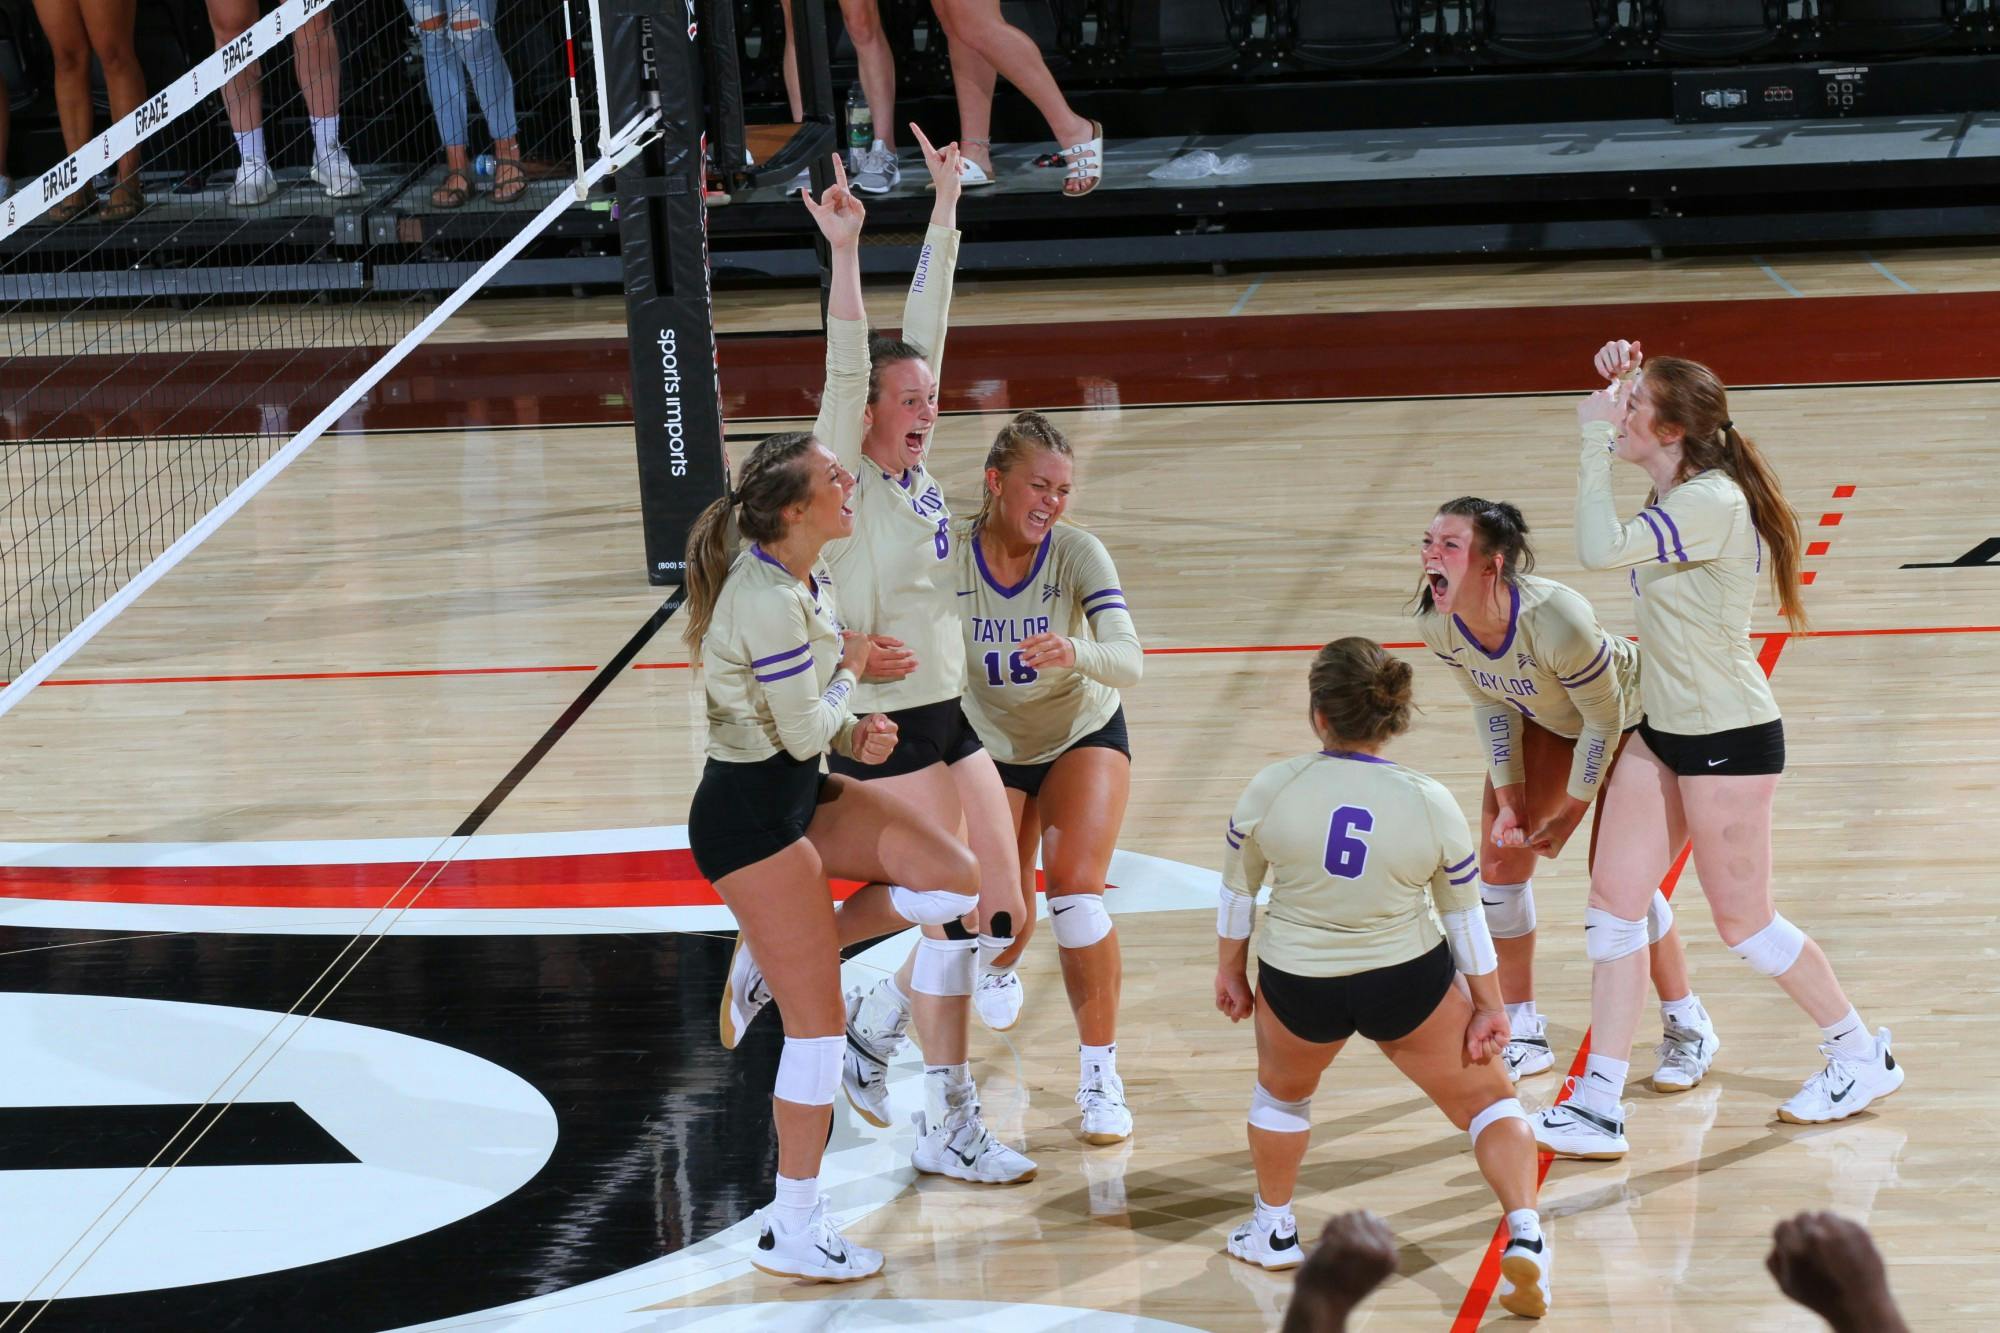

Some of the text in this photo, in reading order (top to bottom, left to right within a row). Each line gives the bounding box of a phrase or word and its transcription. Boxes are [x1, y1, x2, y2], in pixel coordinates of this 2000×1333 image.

[221, 32, 253, 74] GRACE
[135, 92, 168, 136] GRACE
[42, 157, 78, 203] GRACE
[911, 244, 932, 294] TROJANS
[656, 328, 688, 477] sports imports
[657, 562, 677, 570] (800)
[972, 616, 1049, 643] TAYLOR
[984, 650, 1038, 687] 18
[1471, 669, 1538, 697] TAYLOR
[1489, 713, 1512, 766] TAYLOR
[1583, 738, 1606, 785] TROJANS
[1322, 804, 1376, 881] 6
